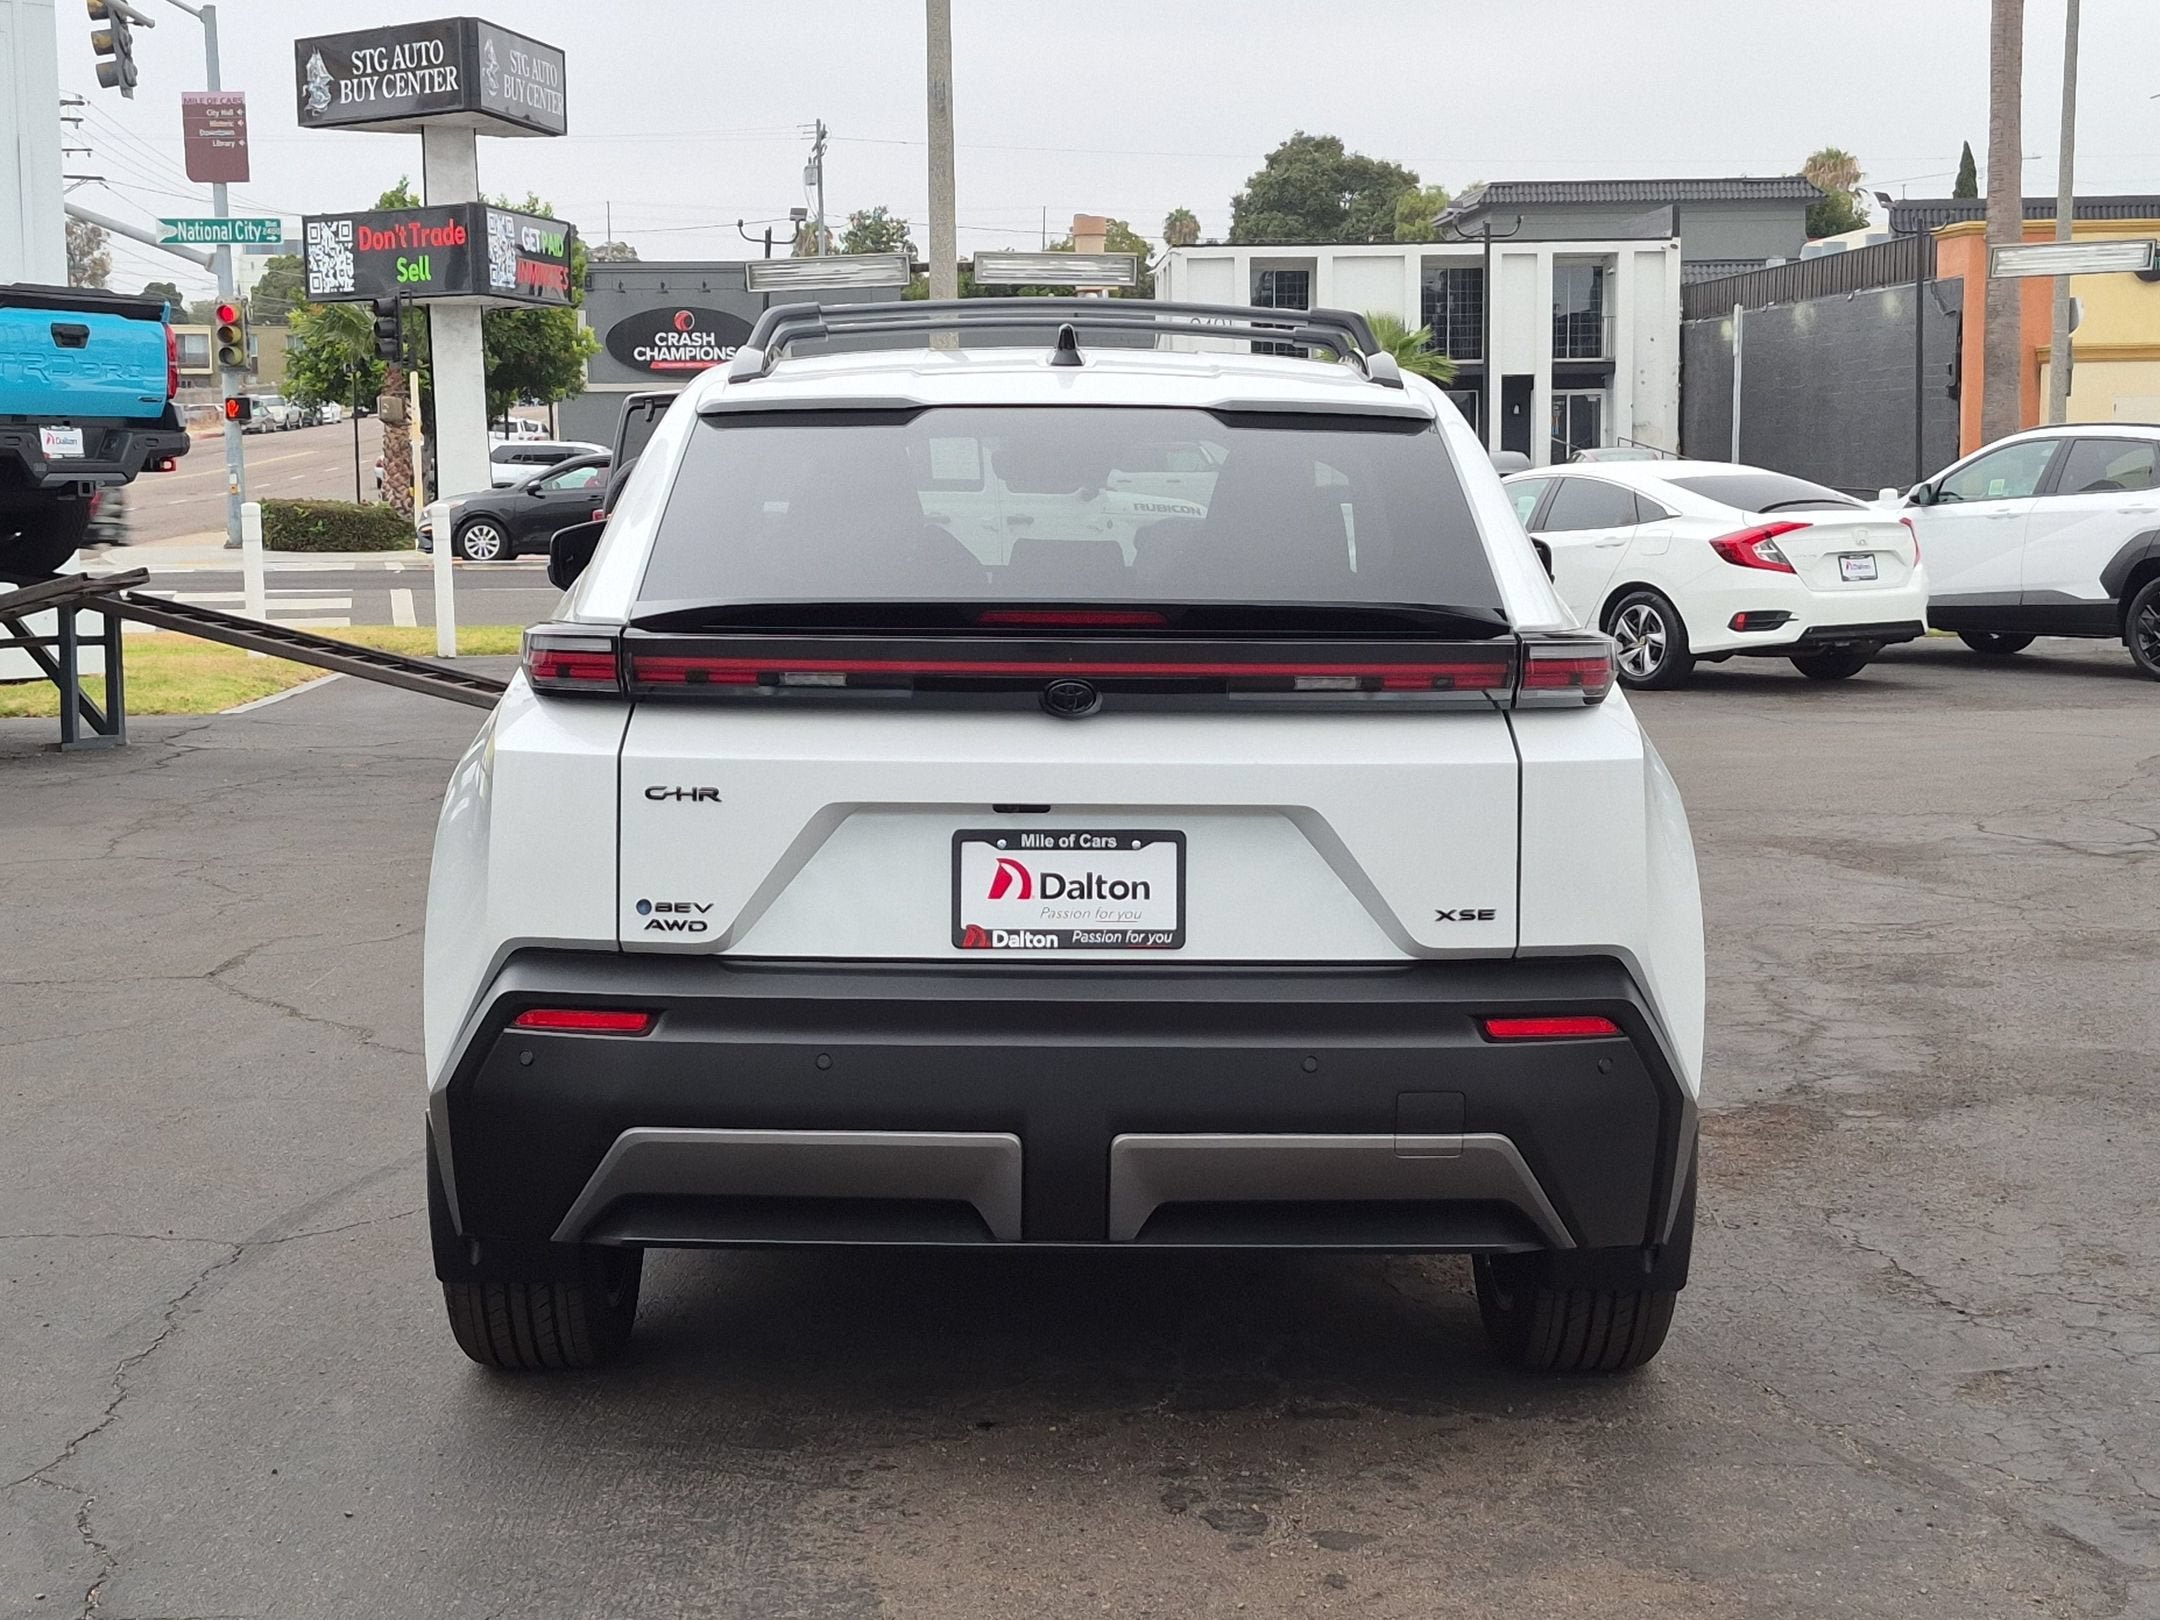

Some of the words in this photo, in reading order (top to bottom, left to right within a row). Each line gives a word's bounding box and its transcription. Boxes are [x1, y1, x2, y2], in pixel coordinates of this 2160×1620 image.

[351, 47, 388, 75] STG
[391, 39, 444, 70] AUTO
[510, 49, 530, 77] STG
[532, 57, 558, 87] AUTO
[339, 76, 379, 104] BUY
[382, 66, 459, 98] CENTER
[504, 74, 525, 103] BUY
[526, 83, 564, 115] CENTER
[178, 221, 232, 241] National
[235, 220, 261, 242] City
[358, 223, 408, 252] Don't
[408, 218, 466, 248] Trade
[396, 255, 431, 283] Sell
[654, 332, 715, 346] CRASH
[633, 346, 737, 361] CHAMPIONS
[1133, 503, 1202, 516] RUBICON
[1021, 834, 1055, 848] Mile
[1058, 834, 1076, 848] of
[1079, 835, 1117, 849] Cars
[1039, 872, 1151, 901] Dalton
[654, 901, 714, 914] BEV
[1040, 906, 1091, 920] Passion
[1093, 906, 1113, 921] for
[1117, 910, 1142, 921] you
[1434, 908, 1497, 922] XSE
[643, 918, 708, 932] AWD
[991, 930, 1058, 948] Dalton
[1072, 930, 1122, 944] Passion
[1126, 931, 1145, 944] for
[1147, 932, 1173, 945] you
